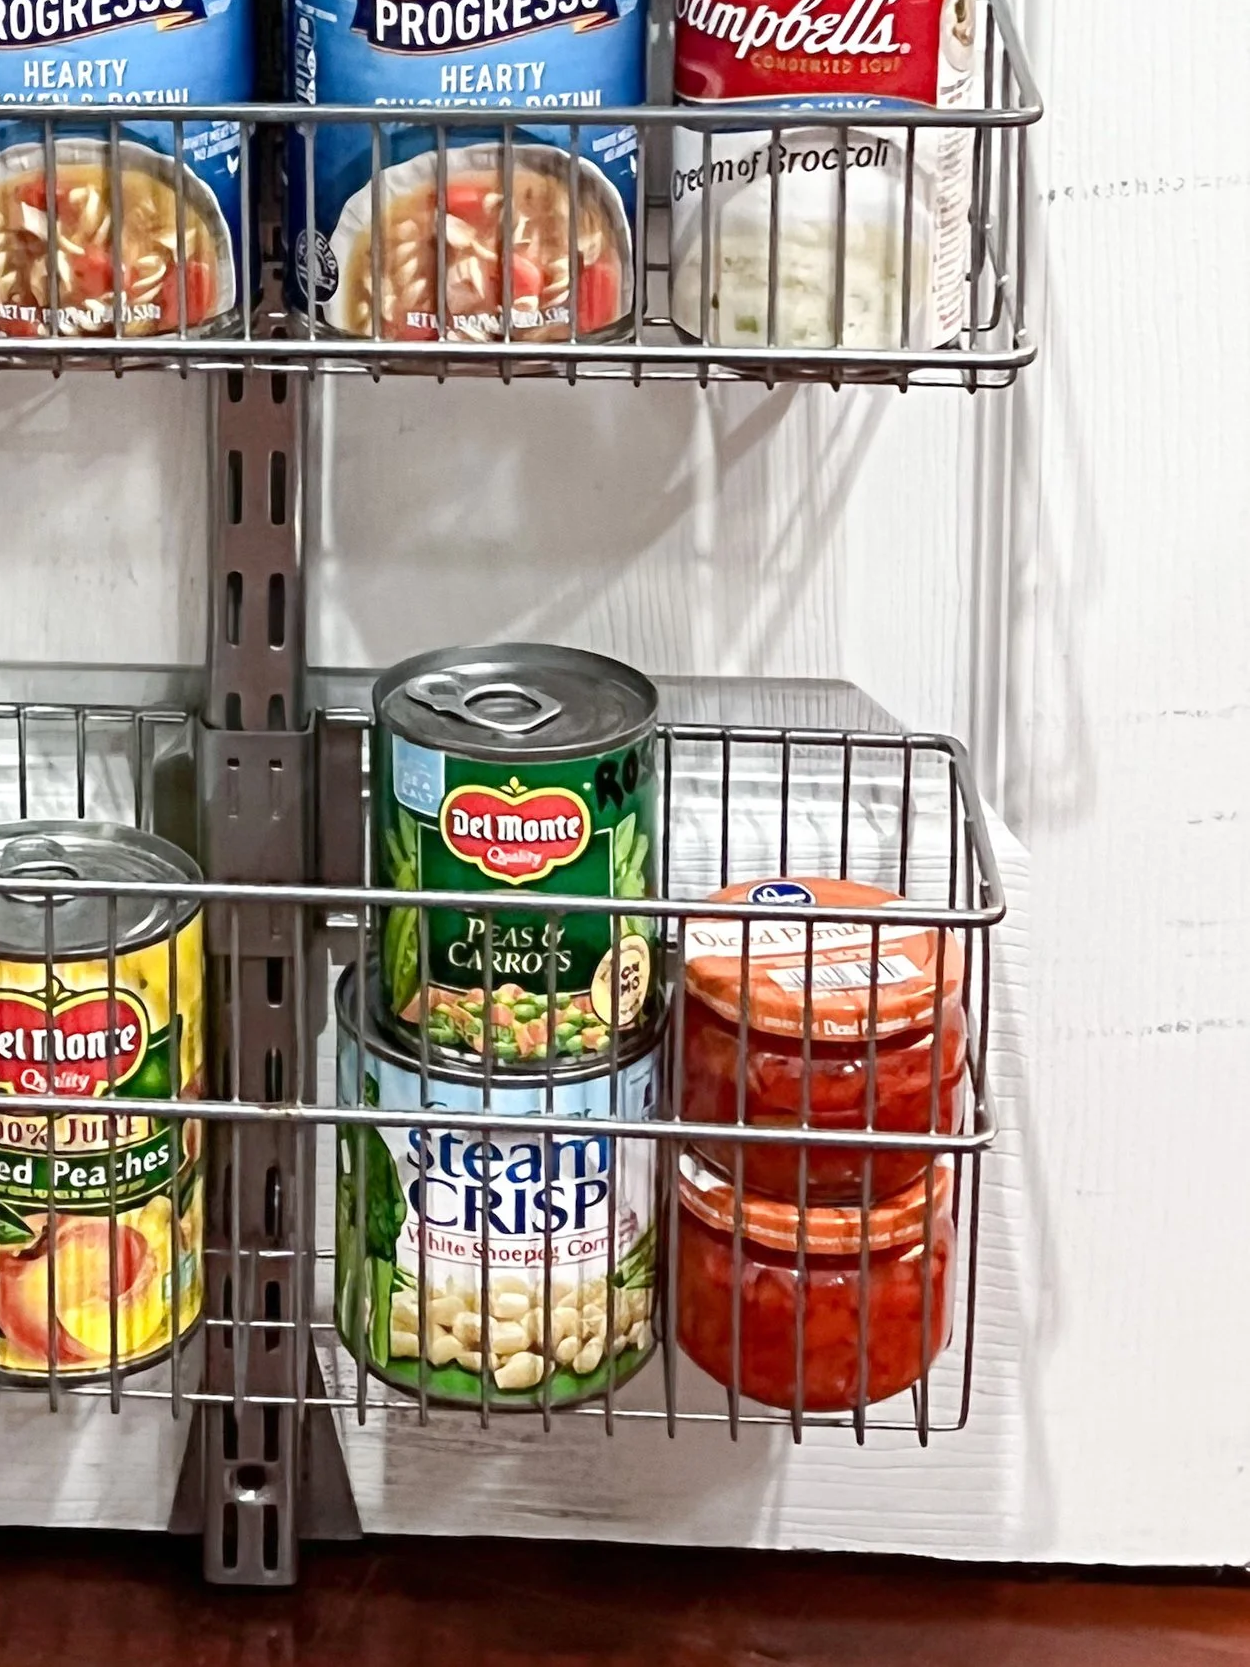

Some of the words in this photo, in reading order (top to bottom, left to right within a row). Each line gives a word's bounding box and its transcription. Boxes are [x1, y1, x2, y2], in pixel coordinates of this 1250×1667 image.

[23, 58, 129, 89] HEARTY
[441, 61, 546, 93] HEARTY
[750, 51, 855, 74] CONDENSED
[737, 150, 763, 184] of
[452, 808, 493, 841] Del
[495, 814, 581, 843] Monte
[486, 846, 543, 868] Quality
[406, 1126, 608, 1184] steam
[408, 1175, 608, 1235] CRISP
